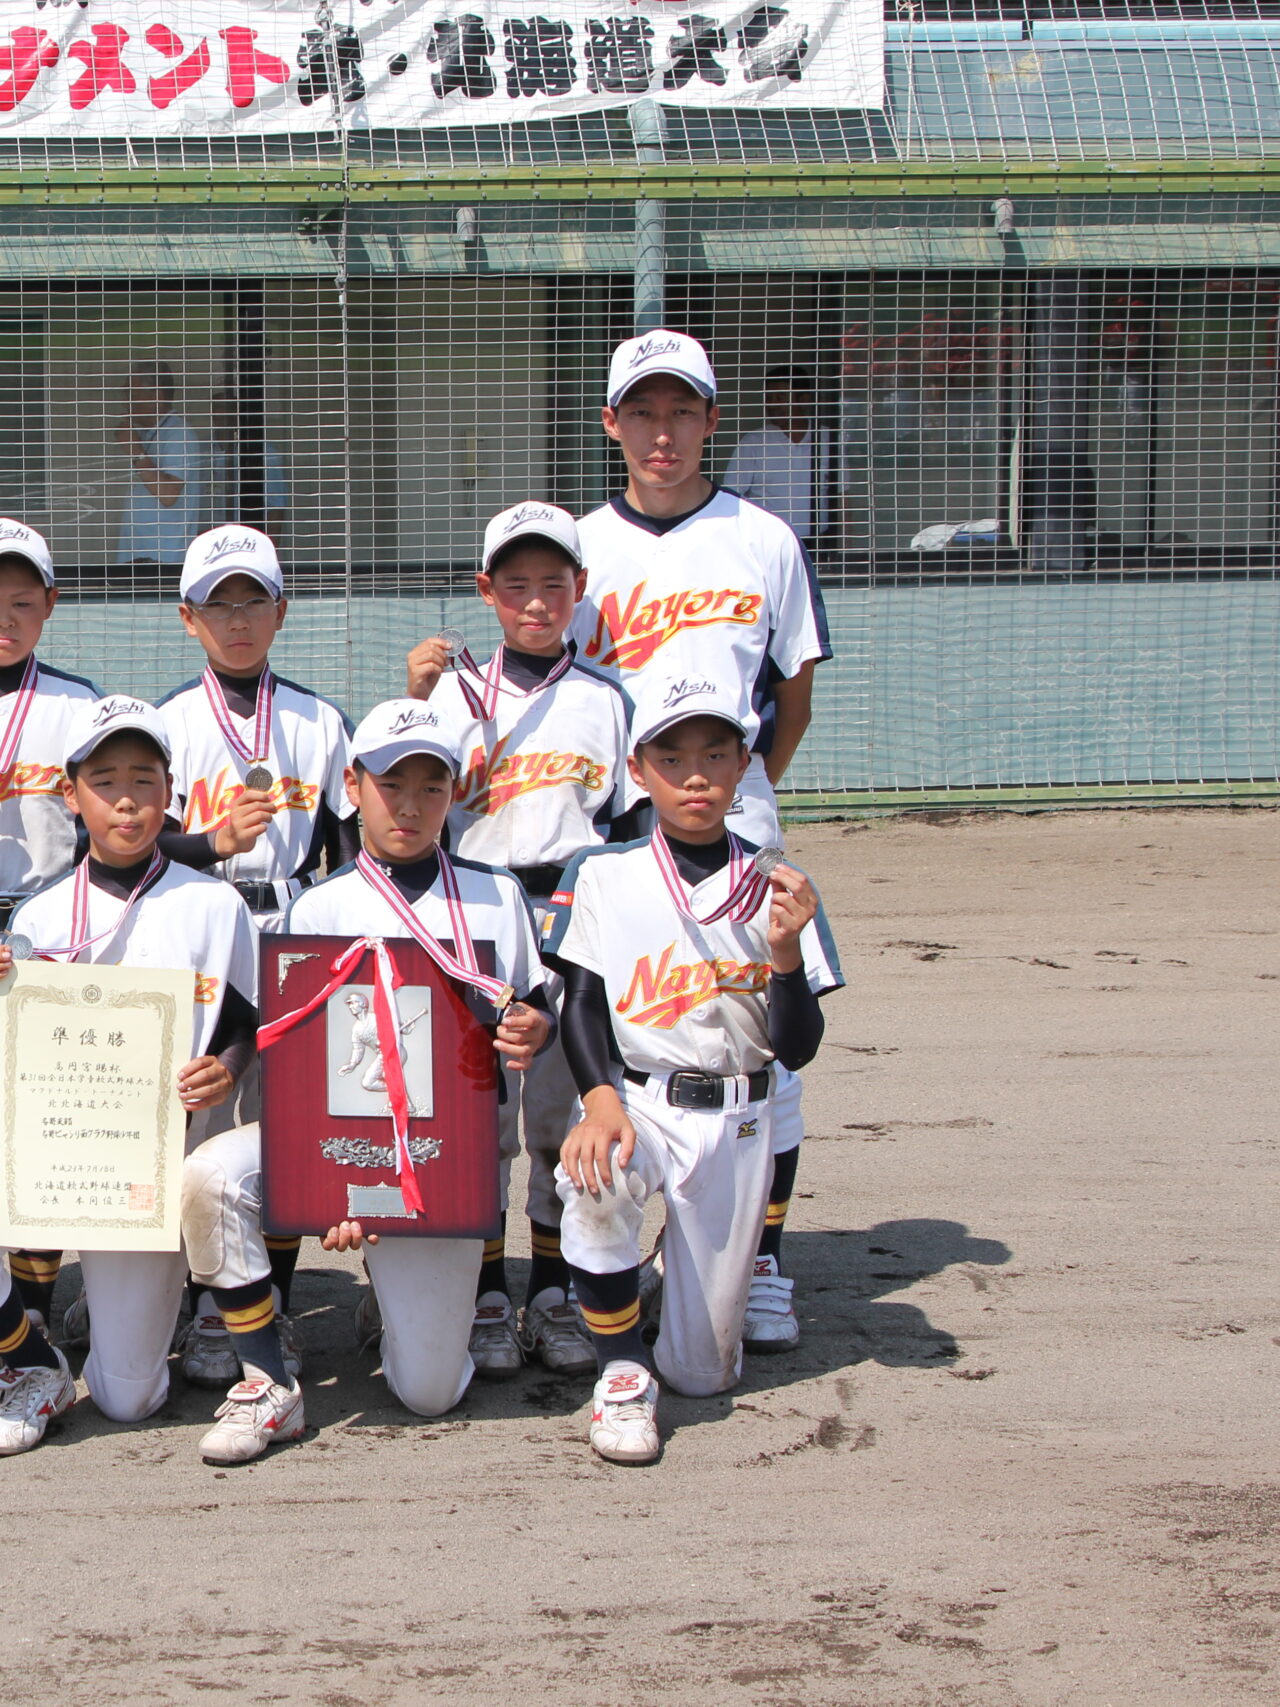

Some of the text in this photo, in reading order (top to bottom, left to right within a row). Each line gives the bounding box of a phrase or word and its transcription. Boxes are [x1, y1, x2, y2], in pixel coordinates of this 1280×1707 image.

[629, 338, 680, 368] Nishi
[504, 506, 555, 535] Nishi
[204, 535, 257, 565] Nishi
[584, 580, 763, 672] Nayoro
[663, 677, 716, 707] Nishi
[93, 699, 145, 727] Nishi
[388, 708, 439, 735] Nishi
[455, 733, 607, 816] Nayoro
[51, 1026, 126, 1047] 準優勝
